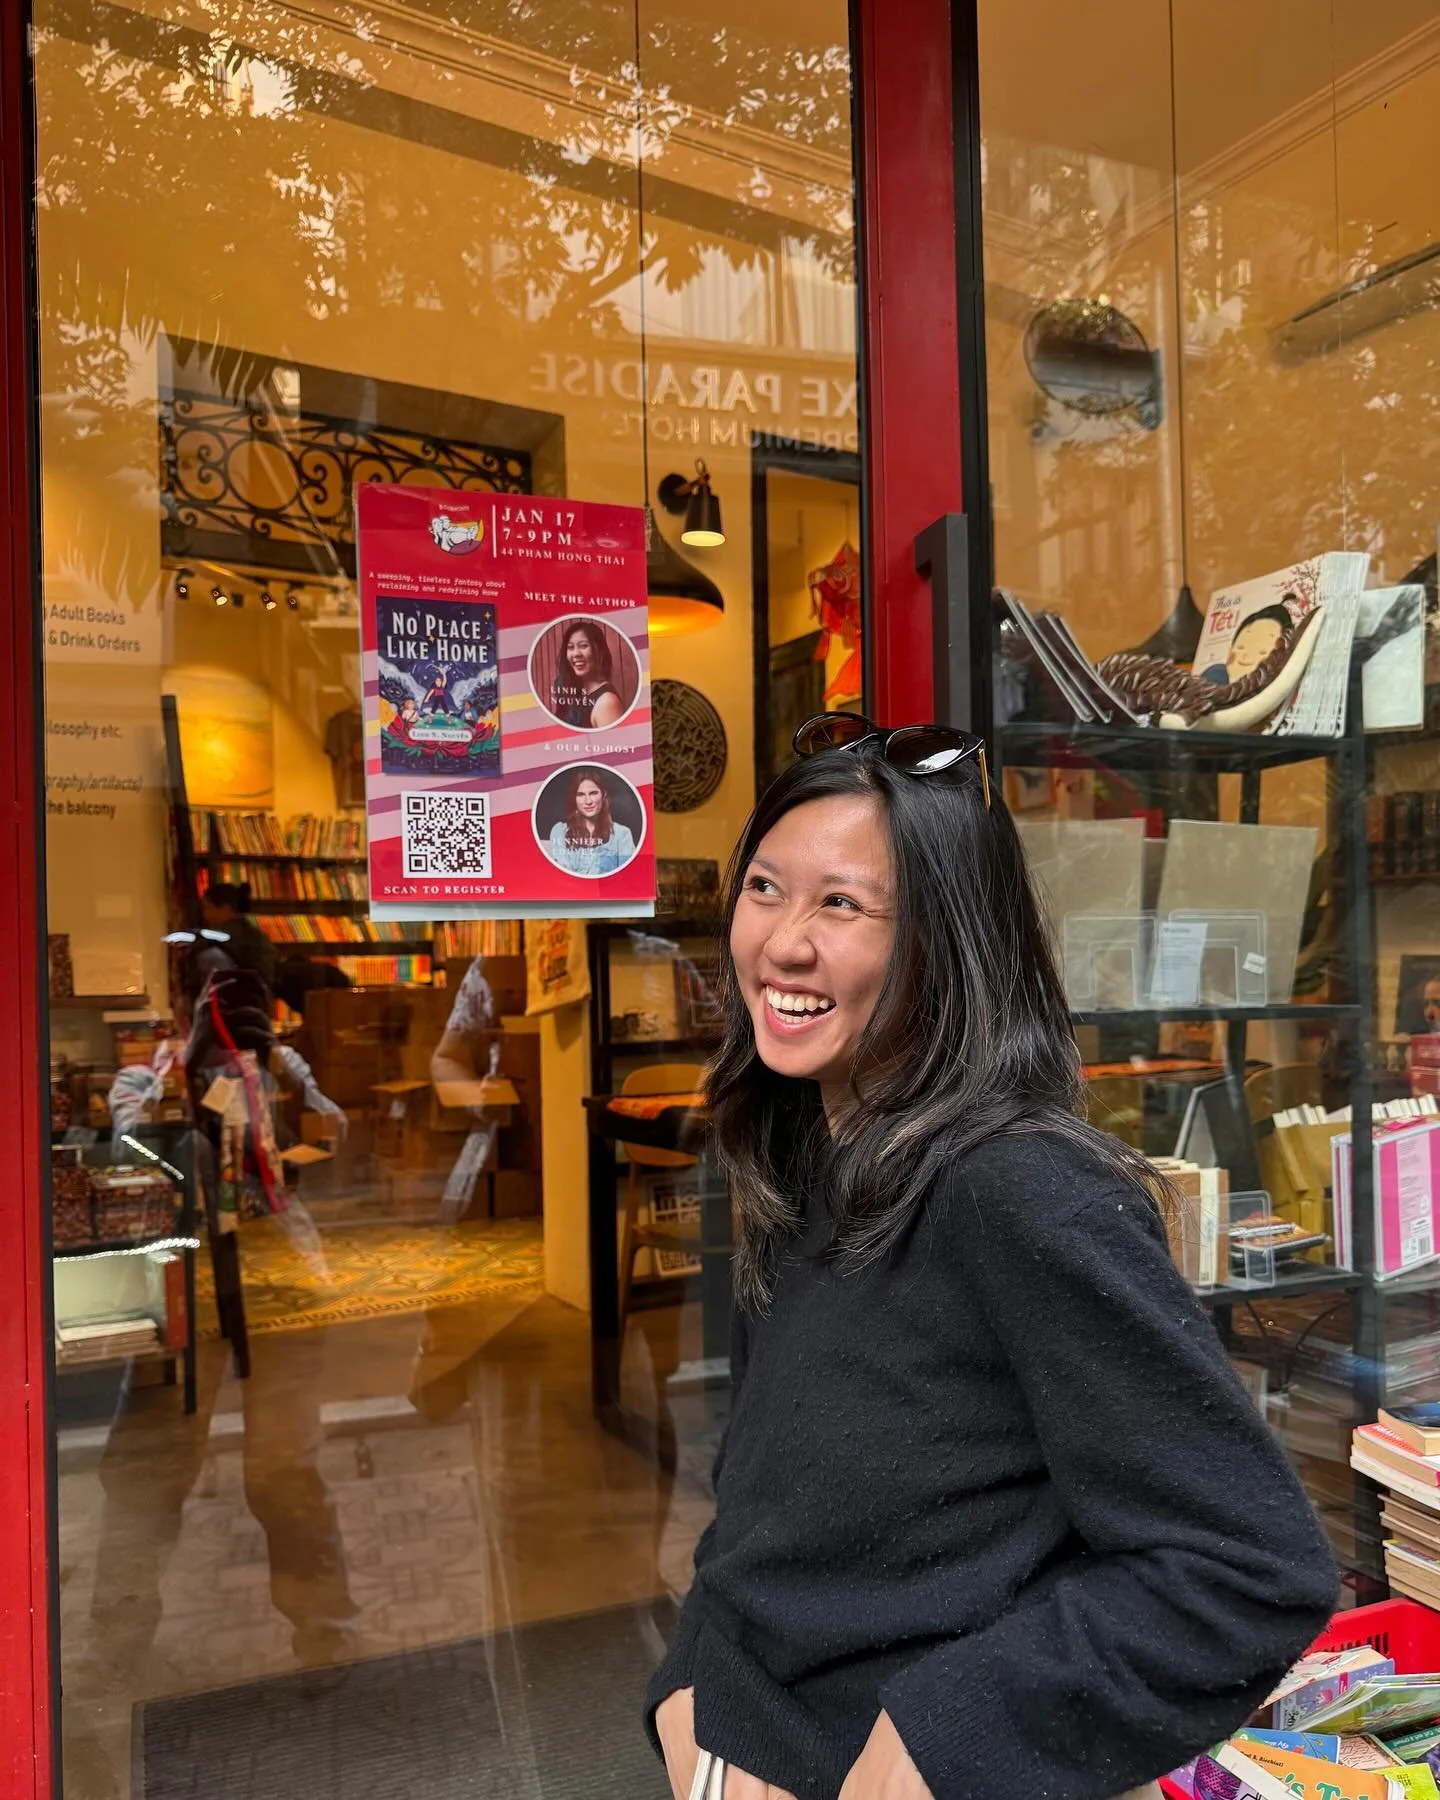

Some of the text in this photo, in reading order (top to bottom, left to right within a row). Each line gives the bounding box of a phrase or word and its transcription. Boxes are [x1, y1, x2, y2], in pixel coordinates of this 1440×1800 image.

[501, 507, 575, 528] JAN 17
[501, 548, 625, 565] 44 PHAM HONG THAI
[418, 576, 451, 584] timeless
[454, 578, 483, 587] fantasy
[485, 580, 506, 589] about
[439, 587, 479, 597] redefining
[524, 592, 636, 608] MEET THE AUTHOR
[49, 604, 126, 626] Adult Books
[425, 614, 482, 640] PLACE
[48, 630, 141, 653] & Drink Orders
[387, 636, 488, 663] LIKE HOME
[556, 743, 579, 752] OUR
[585, 744, 636, 753] CO-HOST
[66, 799, 117, 820] balcony
[383, 885, 505, 895] SCAN TO REGISTER
